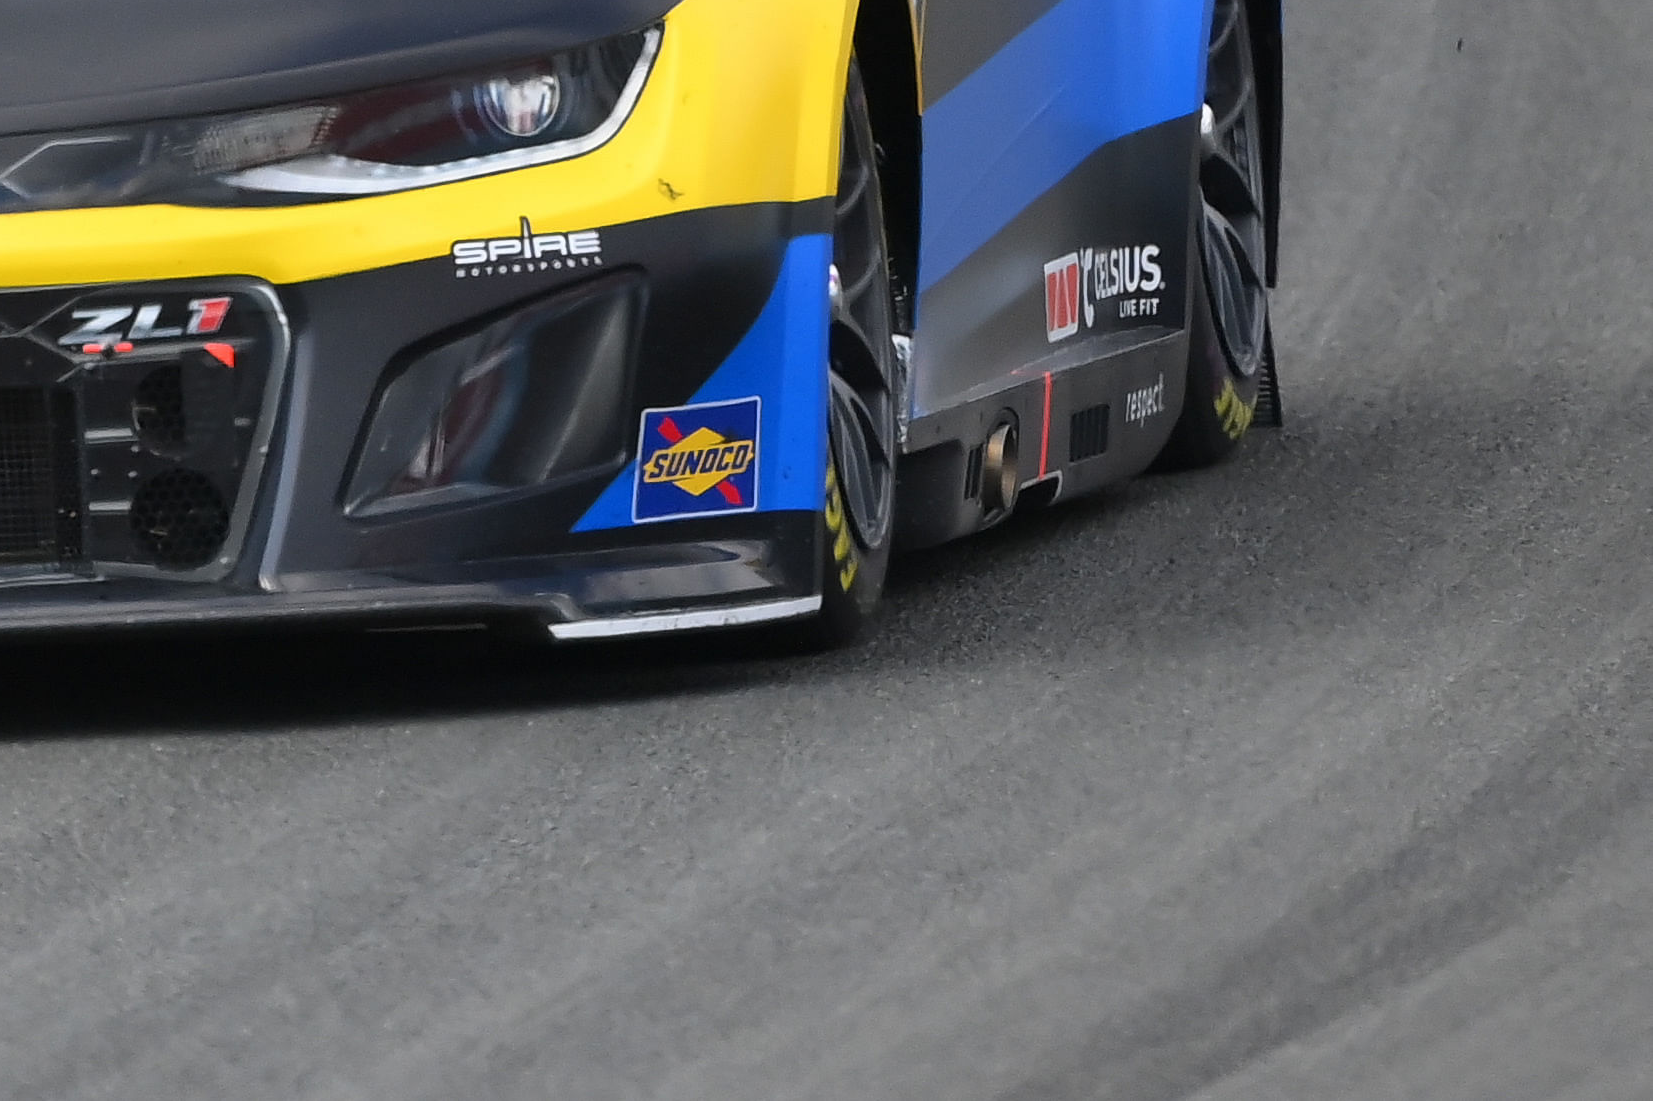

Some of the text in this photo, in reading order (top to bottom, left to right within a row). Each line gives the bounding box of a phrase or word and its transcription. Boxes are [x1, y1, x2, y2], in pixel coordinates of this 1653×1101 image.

[453, 216, 603, 266] SPIRE
[455, 255, 603, 279] MOTORSPORTS
[1095, 244, 1162, 301] CELSIUS
[57, 296, 234, 346] ZL1
[1139, 298, 1160, 316] FIT
[648, 444, 751, 480] SUNOCO
